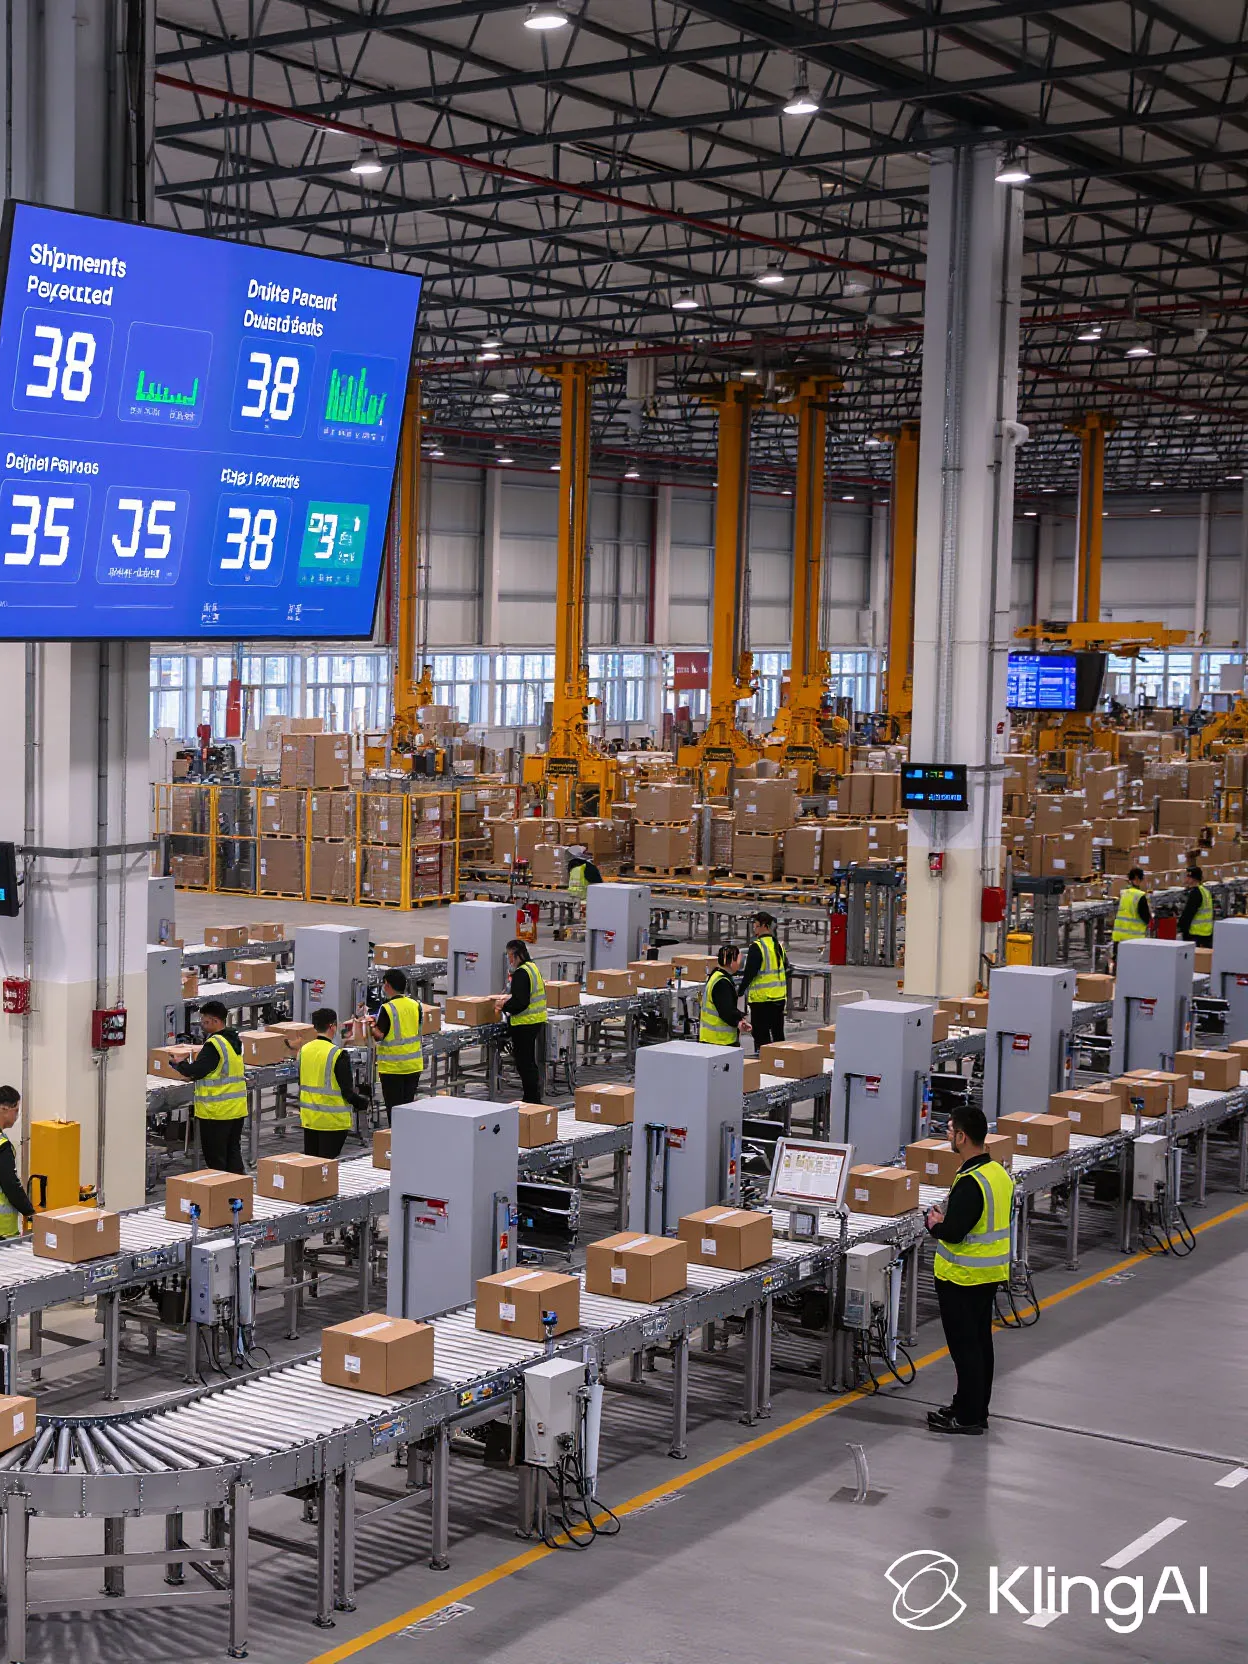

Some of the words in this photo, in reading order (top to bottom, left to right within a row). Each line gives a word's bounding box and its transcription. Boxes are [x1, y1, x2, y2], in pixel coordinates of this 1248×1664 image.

[26, 326, 96, 402] 38
[241, 352, 299, 420] 38
[4, 495, 74, 565] 35
[221, 508, 277, 569] 38
